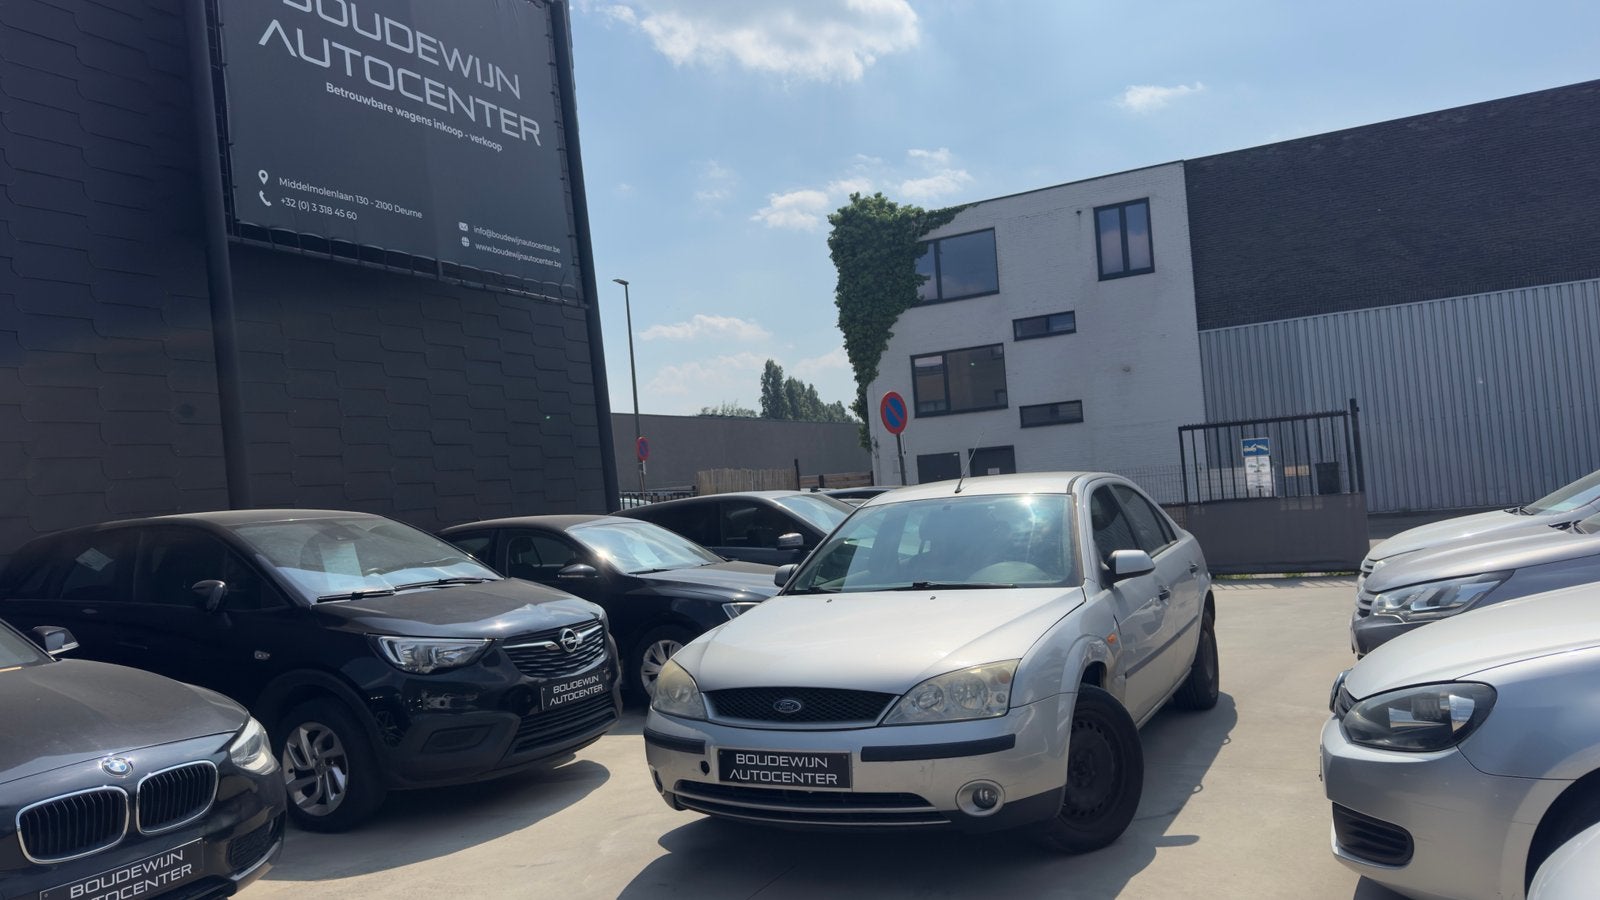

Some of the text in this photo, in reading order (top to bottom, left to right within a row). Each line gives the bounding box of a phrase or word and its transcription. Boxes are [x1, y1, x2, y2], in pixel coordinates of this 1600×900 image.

[258, 19, 541, 147] AUTOCENTER
[326, 82, 394, 113] Betrouwbare
[395, 107, 432, 127] wagens
[433, 118, 464, 139] inkoop
[469, 133, 503, 152] verkoop
[279, 177, 355, 202] Middelmolenlaan
[355, 195, 369, 206] 130
[375, 200, 393, 211] 2100
[394, 204, 423, 219] Deurne
[281, 197, 358, 221] +32 (0) 3 318 45 60
[473, 225, 560, 254] info@boudewijnautocenter.be
[475, 243, 562, 268] www.boudewijnautocenter.be
[549, 684, 603, 707] AUTOCENTER
[552, 675, 599, 694] BOUDEWIJN
[735, 753, 828, 769] BOUDEWIJN
[729, 769, 838, 785] AUTOCENTER
[70, 850, 184, 899] BOUDEWIJN
